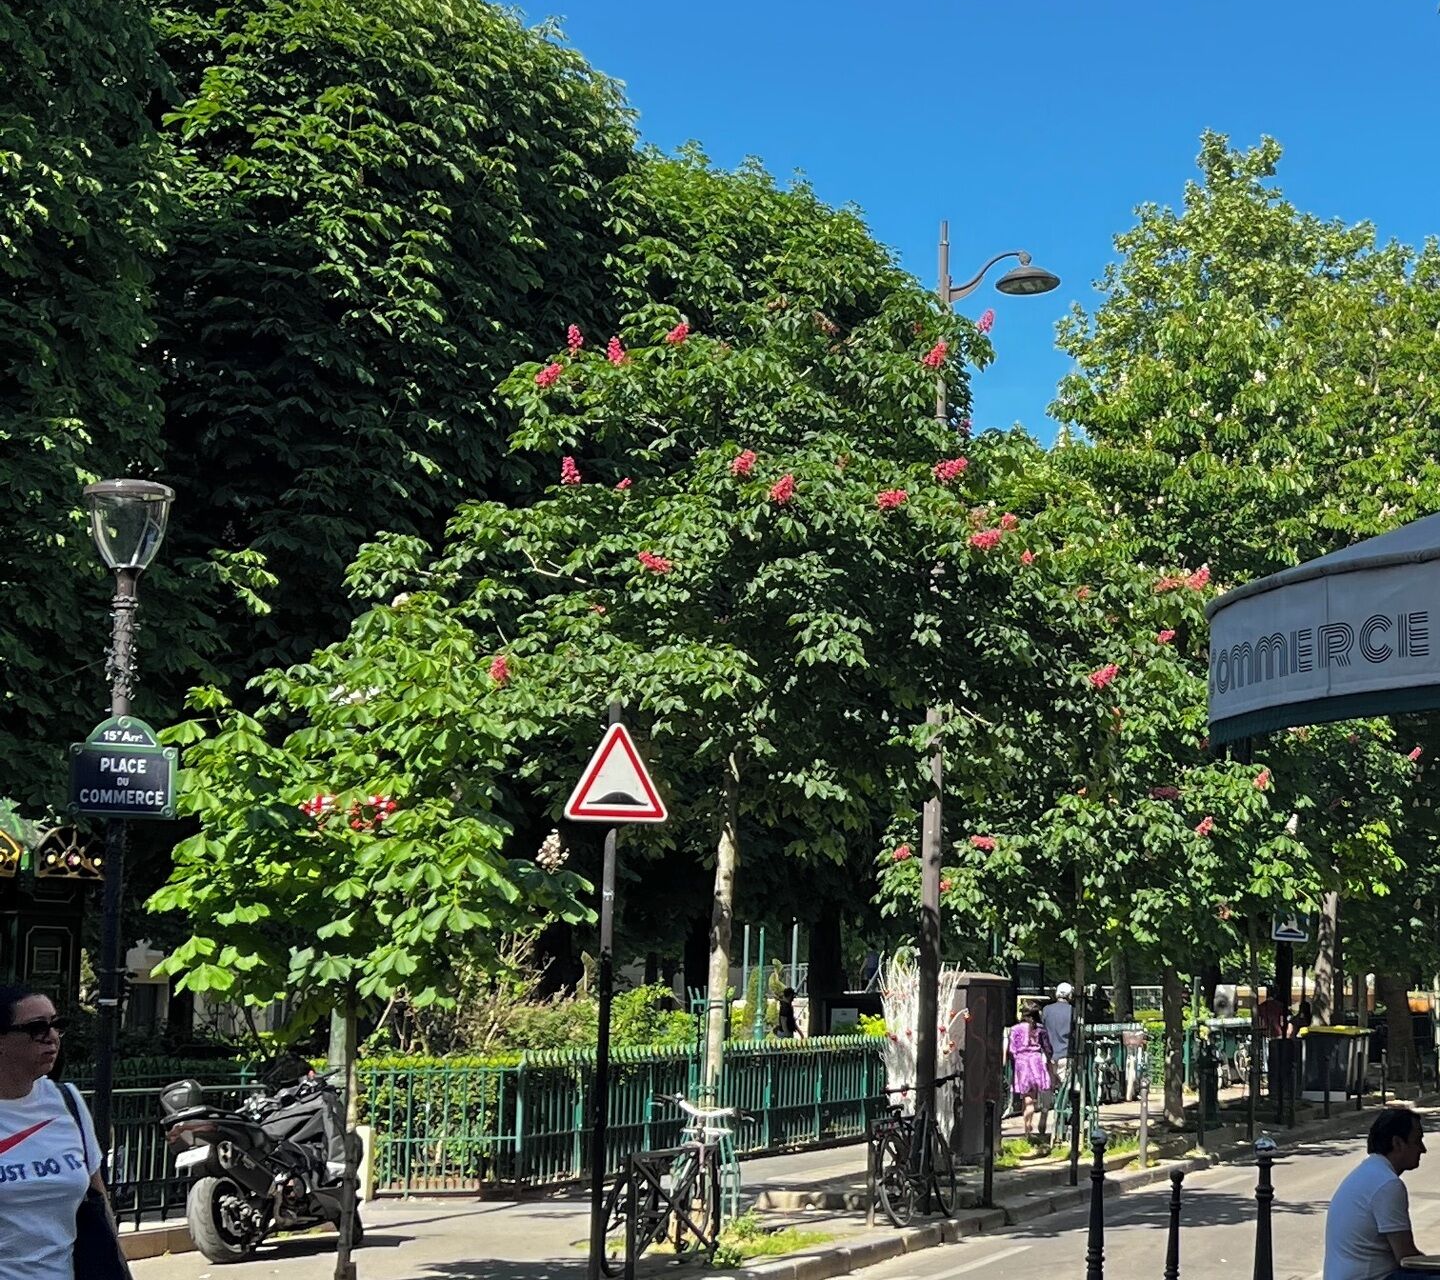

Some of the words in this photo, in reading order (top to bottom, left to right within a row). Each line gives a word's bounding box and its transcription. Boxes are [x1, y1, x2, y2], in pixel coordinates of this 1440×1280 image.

[100, 757, 147, 774] PLACE
[116, 777, 130, 787] DU
[80, 788, 165, 806] COMMERCE
[32, 1158, 61, 1178] DO
